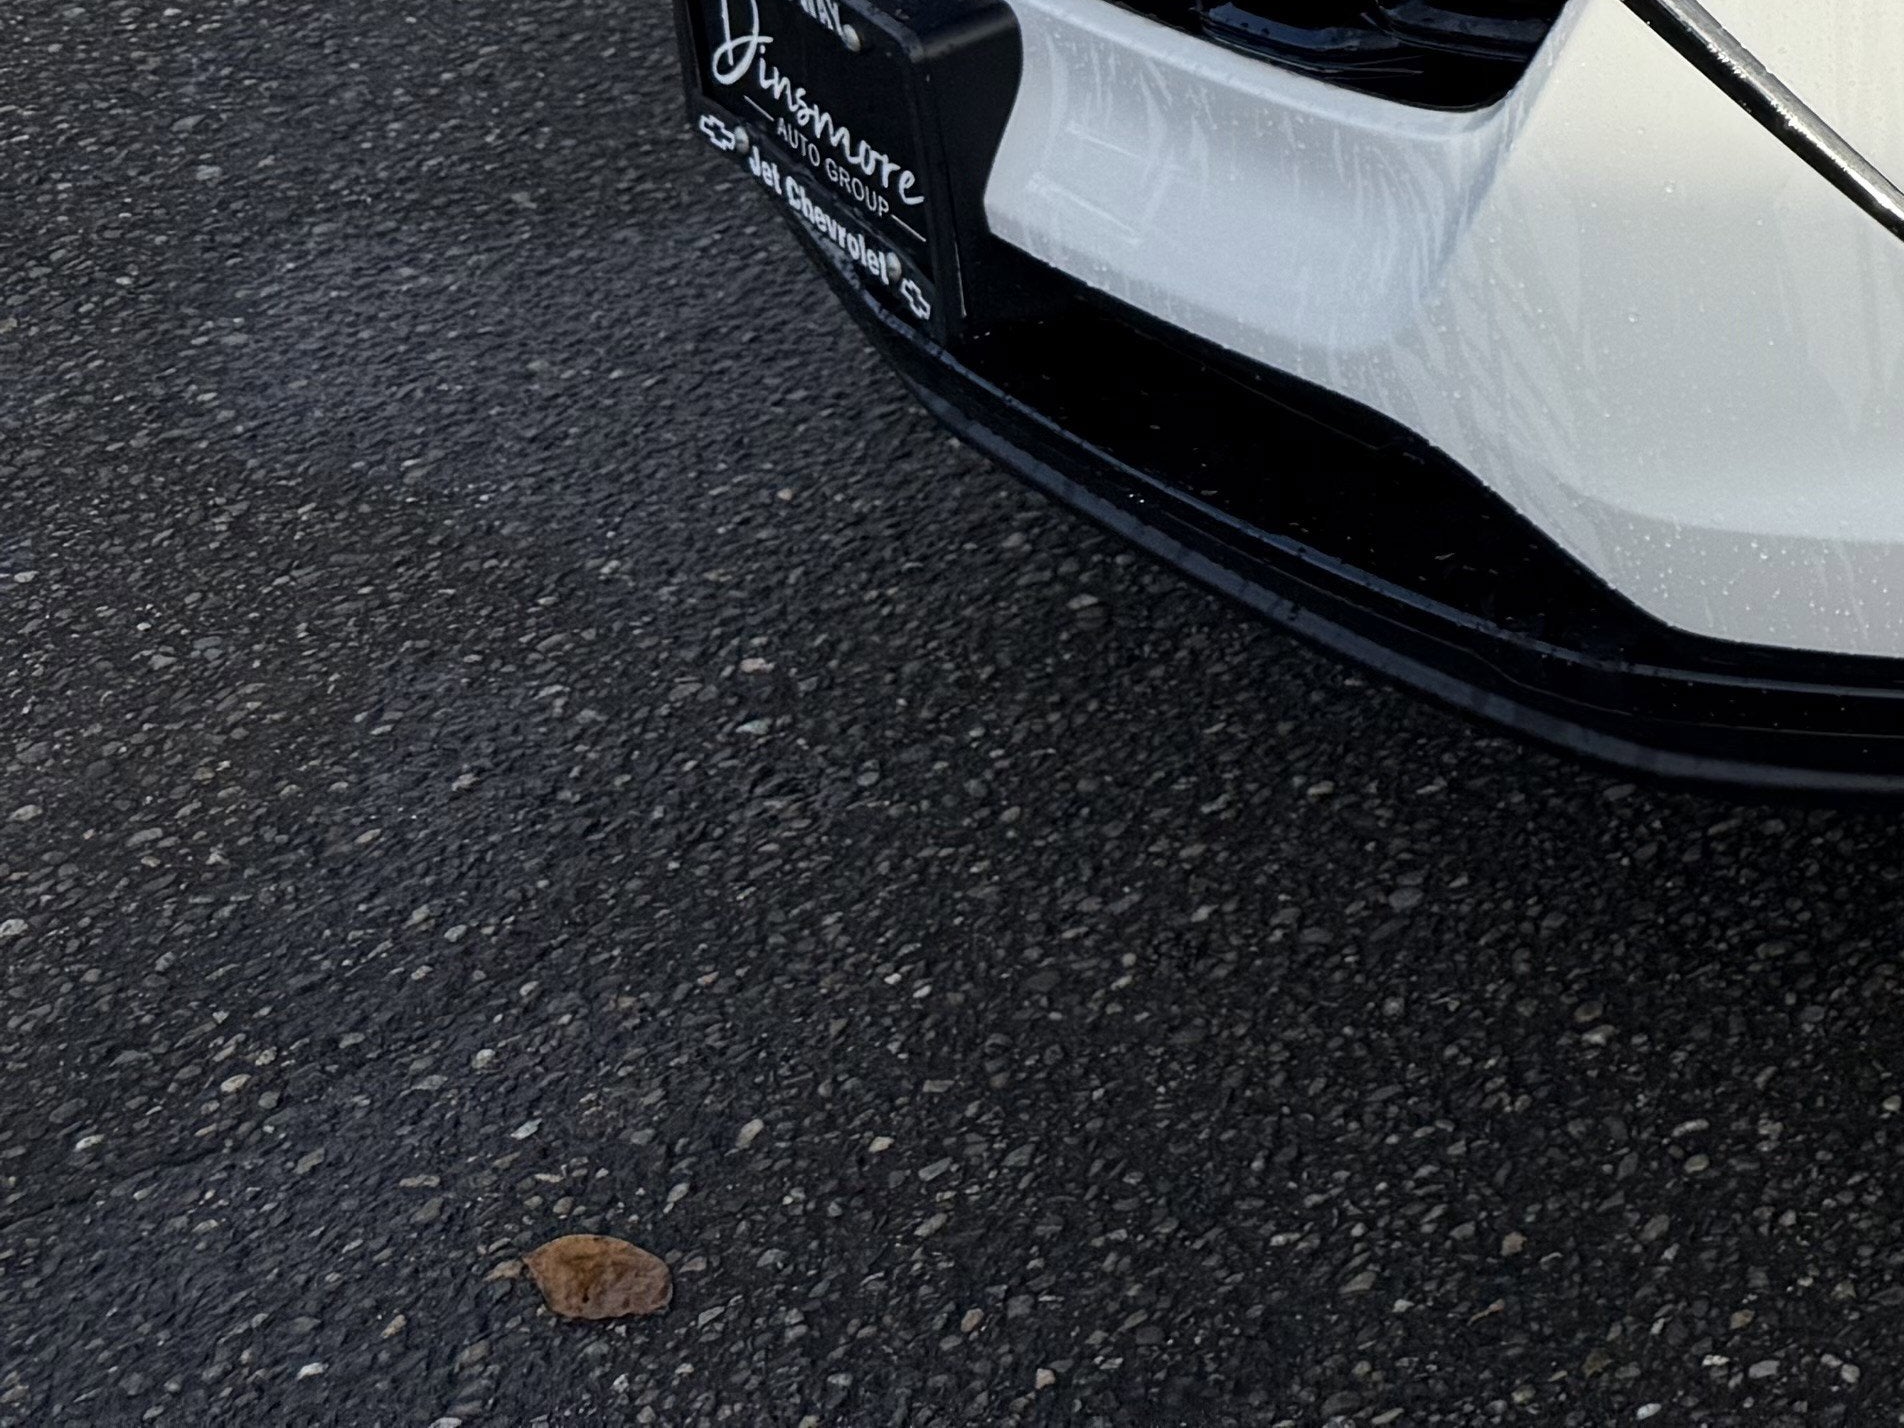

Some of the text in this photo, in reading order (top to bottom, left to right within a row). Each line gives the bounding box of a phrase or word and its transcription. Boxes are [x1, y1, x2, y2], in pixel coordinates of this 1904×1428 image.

[749, 145, 783, 195] Jet
[777, 117, 890, 217] AUTO GROUP
